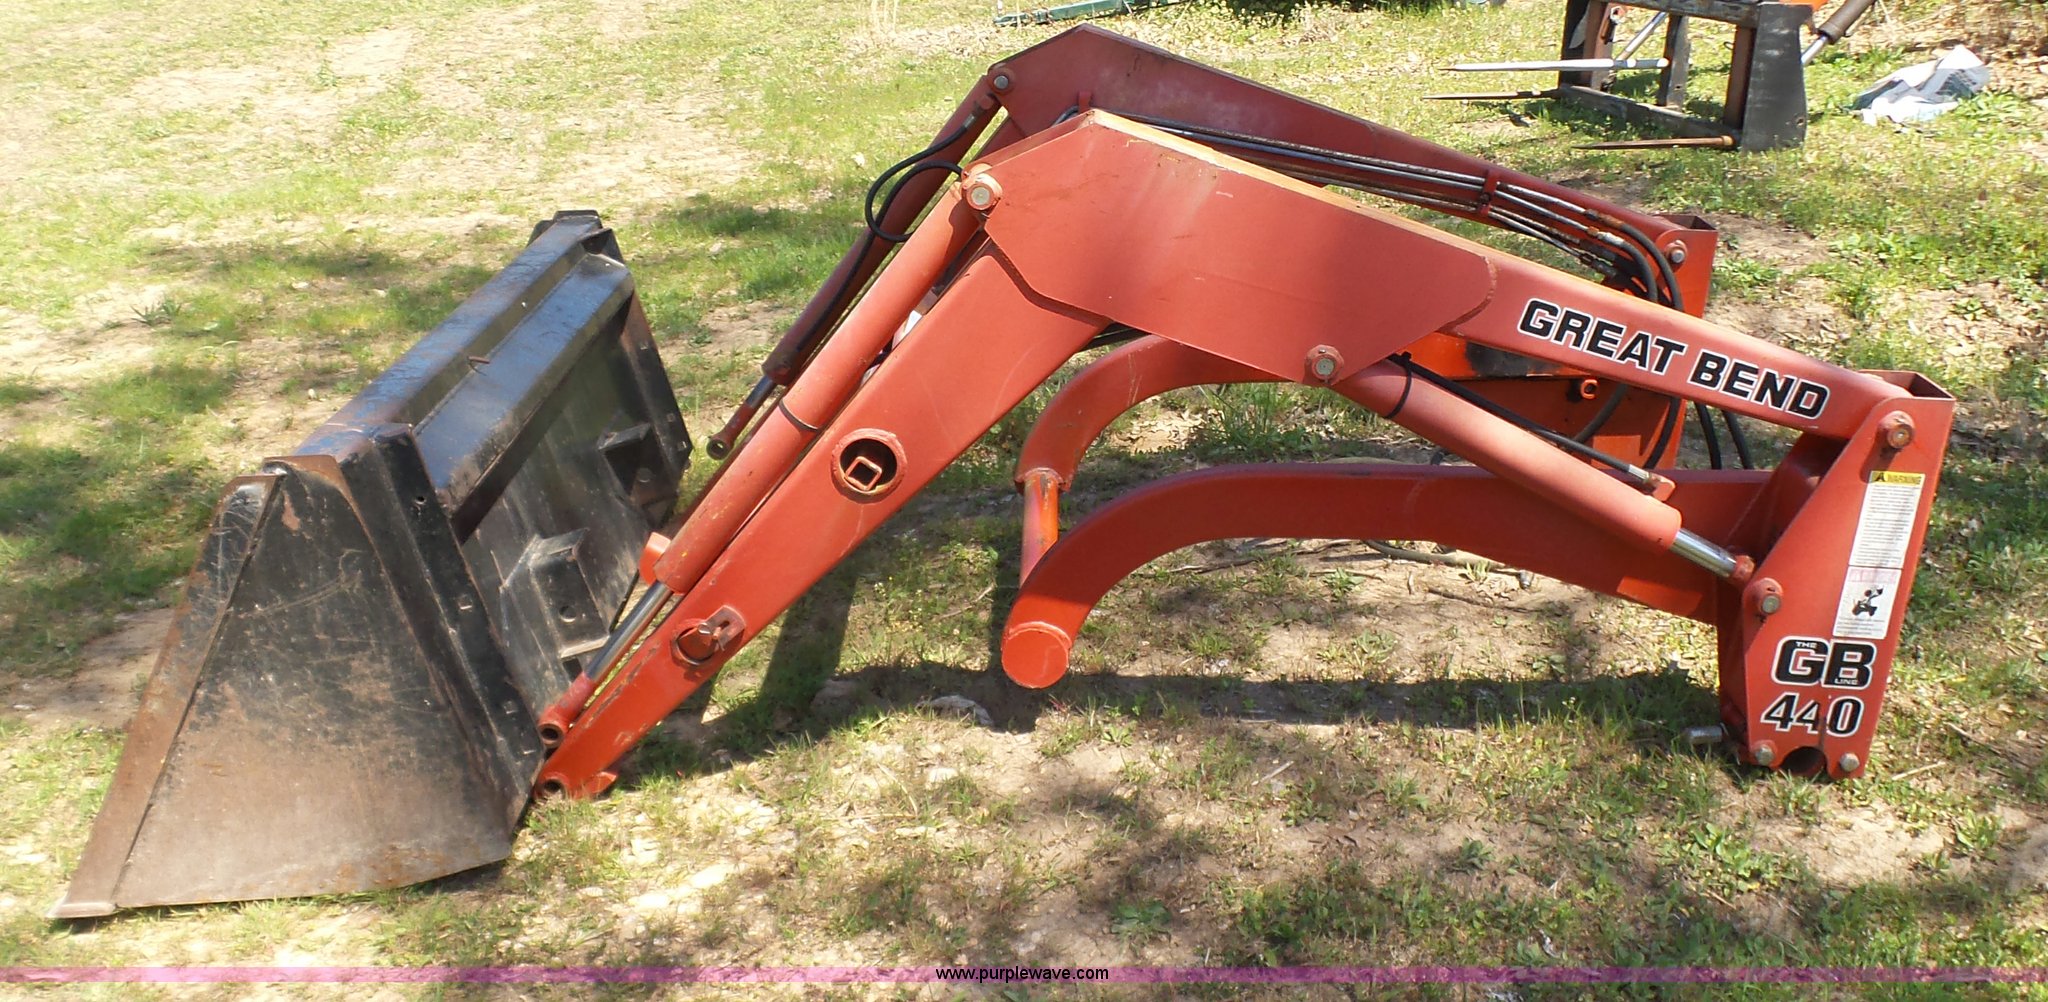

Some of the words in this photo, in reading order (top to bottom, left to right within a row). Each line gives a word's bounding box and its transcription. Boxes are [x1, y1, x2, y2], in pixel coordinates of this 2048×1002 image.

[1518, 298, 1687, 375] GREAT
[1688, 349, 1830, 419] BEND
[1771, 635, 1877, 690] GB
[1795, 641, 1817, 649] THE
[1834, 678, 1859, 686] LINE
[1760, 692, 1864, 737] 440
